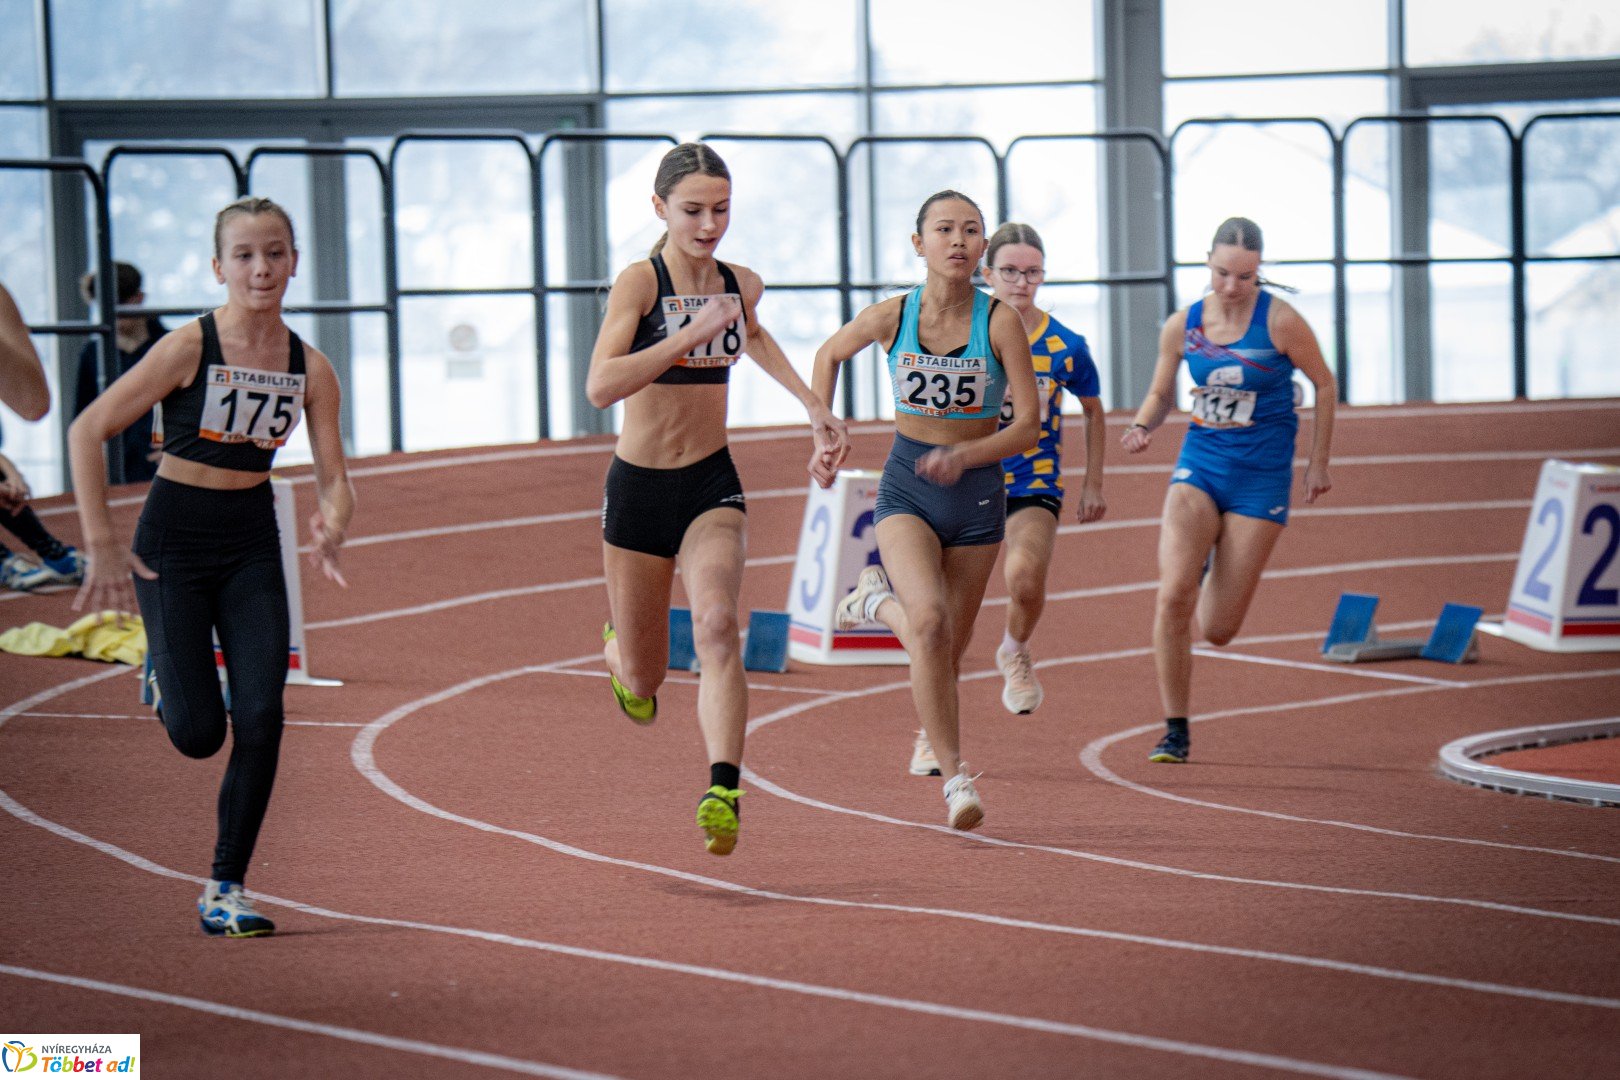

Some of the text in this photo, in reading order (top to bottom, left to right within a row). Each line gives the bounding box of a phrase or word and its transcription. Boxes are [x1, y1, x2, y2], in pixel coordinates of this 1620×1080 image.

[233, 371, 300, 387] STABILITA
[917, 355, 980, 368] STABILITA
[220, 388, 294, 438] 175
[906, 371, 976, 409] 235
[801, 505, 830, 613] 3
[1523, 497, 1565, 603] 2
[1576, 503, 1620, 606] 2
